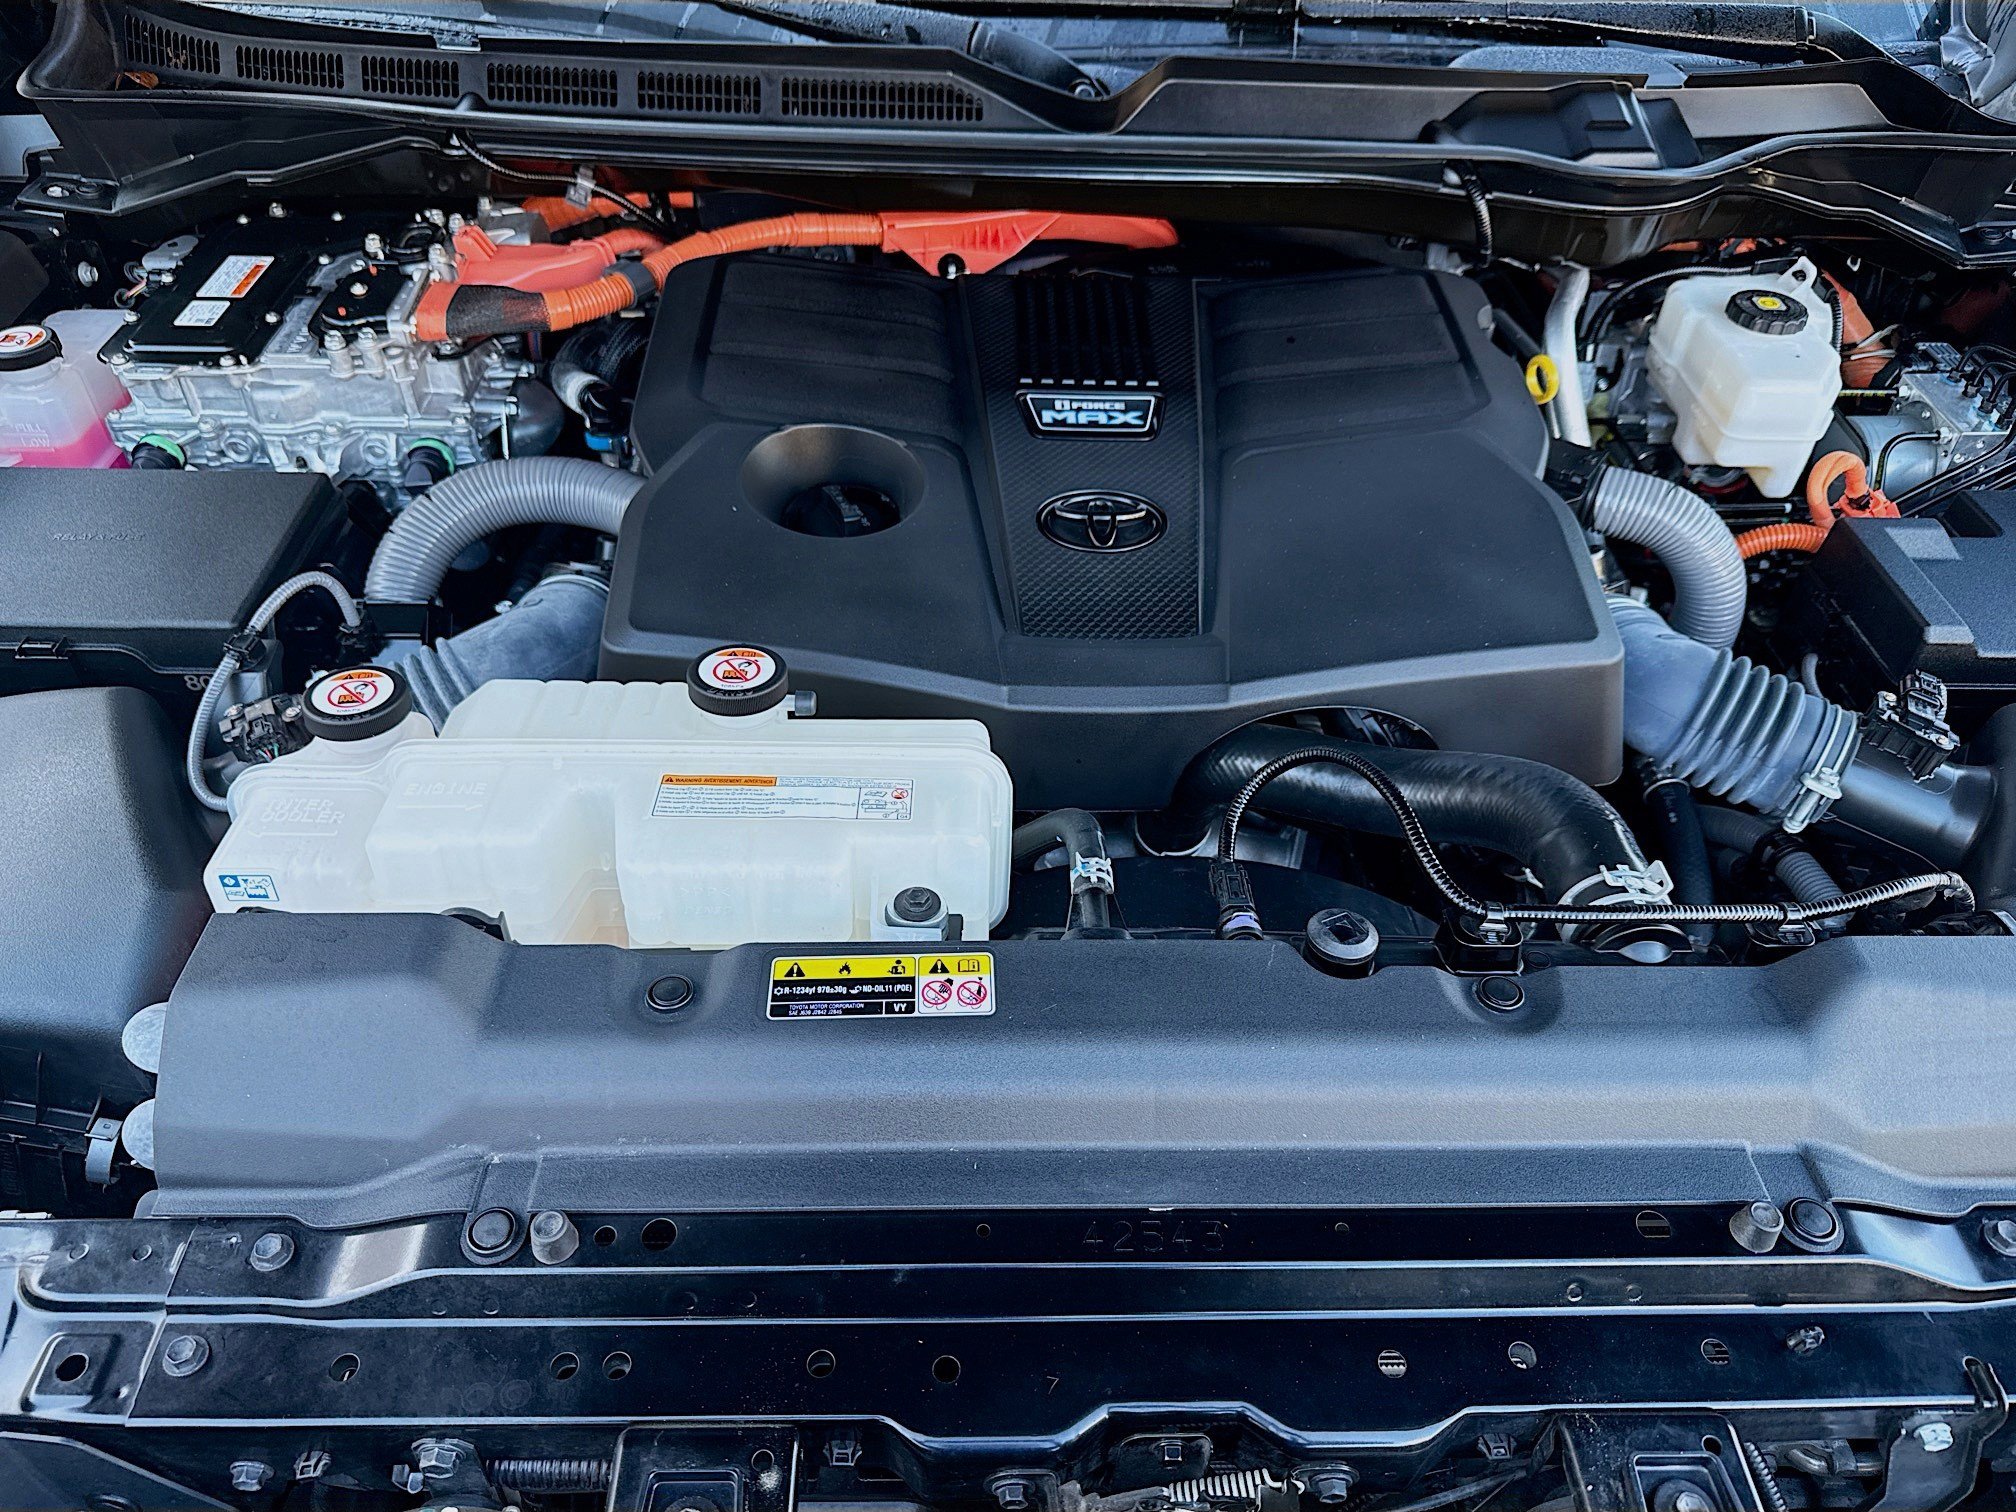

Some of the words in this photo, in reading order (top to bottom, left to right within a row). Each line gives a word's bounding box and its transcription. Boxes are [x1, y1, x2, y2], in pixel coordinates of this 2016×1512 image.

[1041, 410, 1145, 425] MAX
[21, 438, 50, 448] LOW
[403, 782, 488, 796] ENGINE
[266, 798, 335, 812] INTER
[260, 811, 346, 824] COOLER
[783, 986, 816, 996] R-1234yf
[894, 984, 913, 993] (POE)
[893, 1003, 907, 1012] VY
[1082, 1219, 1225, 1253] 42543
